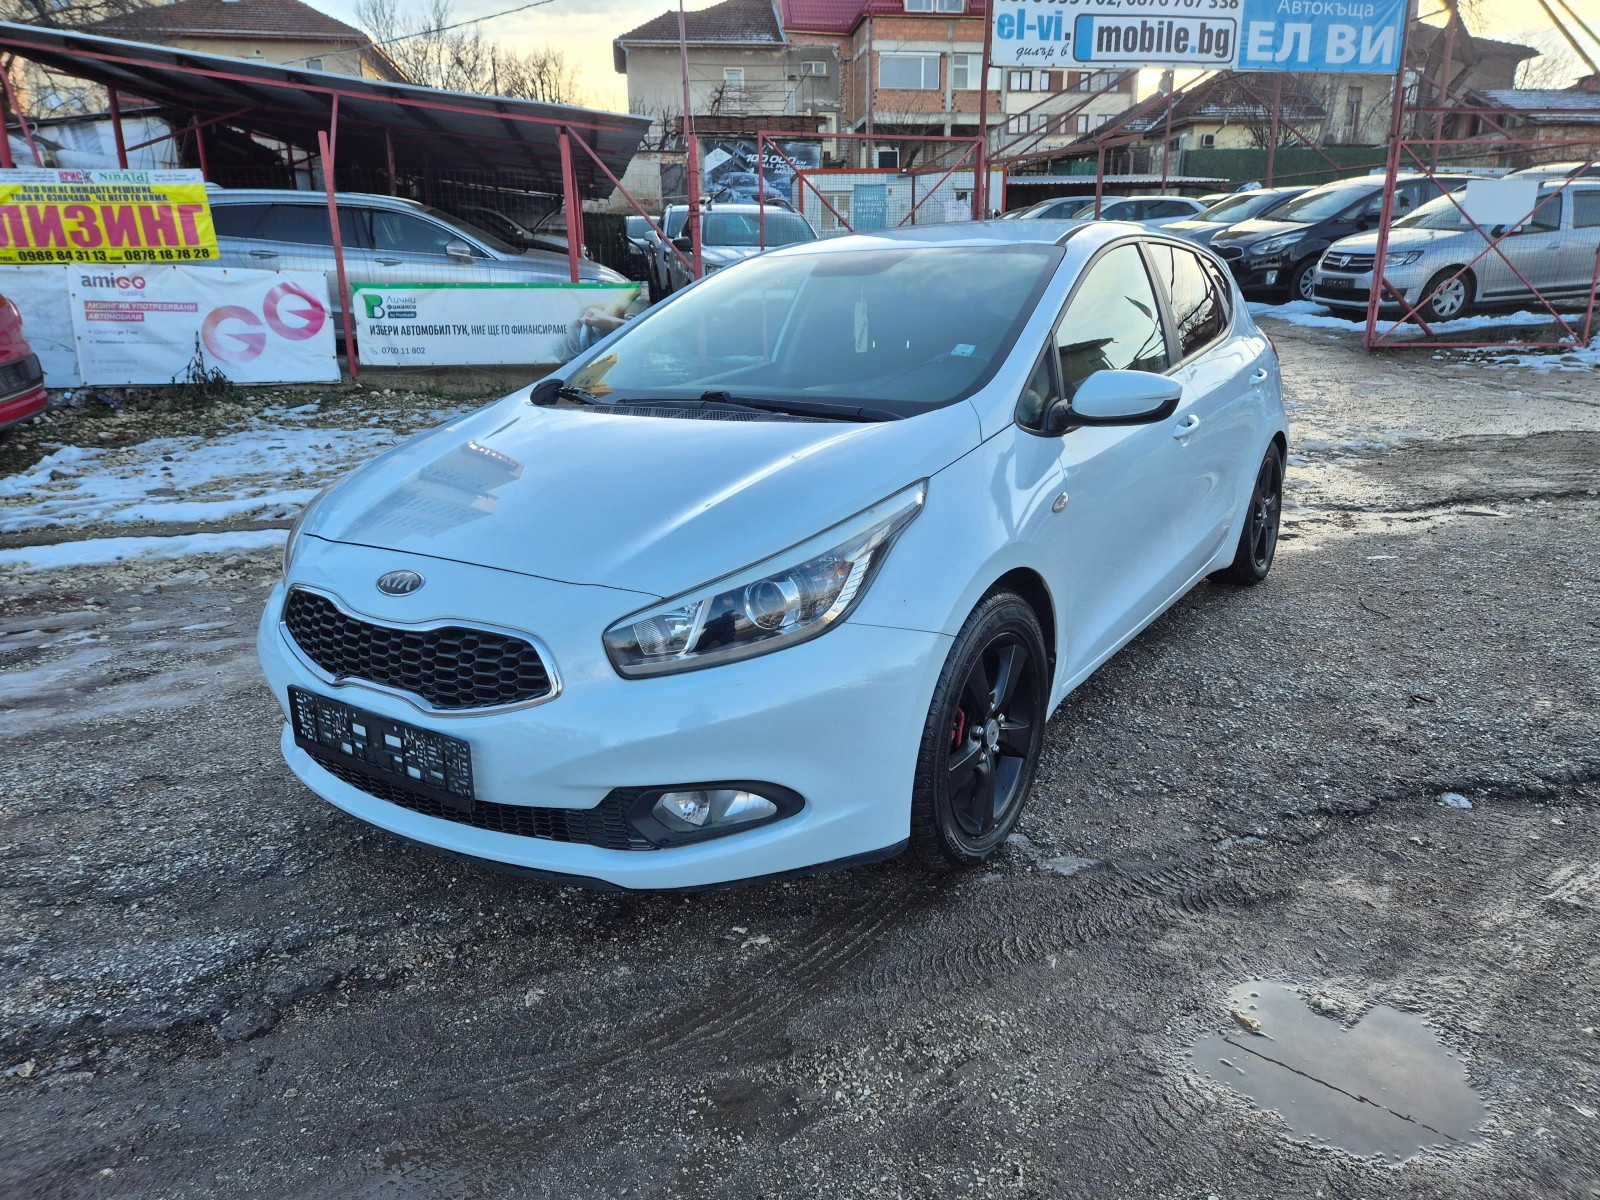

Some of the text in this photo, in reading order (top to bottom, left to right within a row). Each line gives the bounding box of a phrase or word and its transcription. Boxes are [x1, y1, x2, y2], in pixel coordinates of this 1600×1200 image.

[1277, 0, 1374, 20] Автокъща
[1096, 20, 1230, 58] mobile.bg
[1247, 21, 1395, 65] ЕЛ ВИ
[1016, 45, 1055, 61] дилър
[70, 186, 111, 194] ВИЖДАТЕ
[108, 194, 129, 202] НЕГО
[131, 194, 140, 202] ГО
[0, 204, 203, 248] ЛИЗИНГ
[18, 250, 54, 262] 0988
[57, 250, 73, 261] 84
[76, 250, 91, 261] 31
[92, 250, 107, 261] 13
[124, 250, 156, 261] 0878
[159, 250, 173, 260] 18
[176, 249, 190, 260] 78
[193, 248, 210, 259] 28
[119, 289, 146, 298] leasing
[386, 296, 417, 304] Лични
[87, 302, 196, 311] ЛИЗИНГ НА УПОТРЕБЯВАНИ
[88, 312, 142, 320] АВТОМОБИЛИ
[370, 324, 568, 337] ИЗБЕРИ АВТОМОБИЛ ТУК, НИЕ ЩЕ ГО ФИНАНСИРАМЕ
[381, 346, 426, 355] 0700 11 802
[379, 572, 418, 593] KIA
